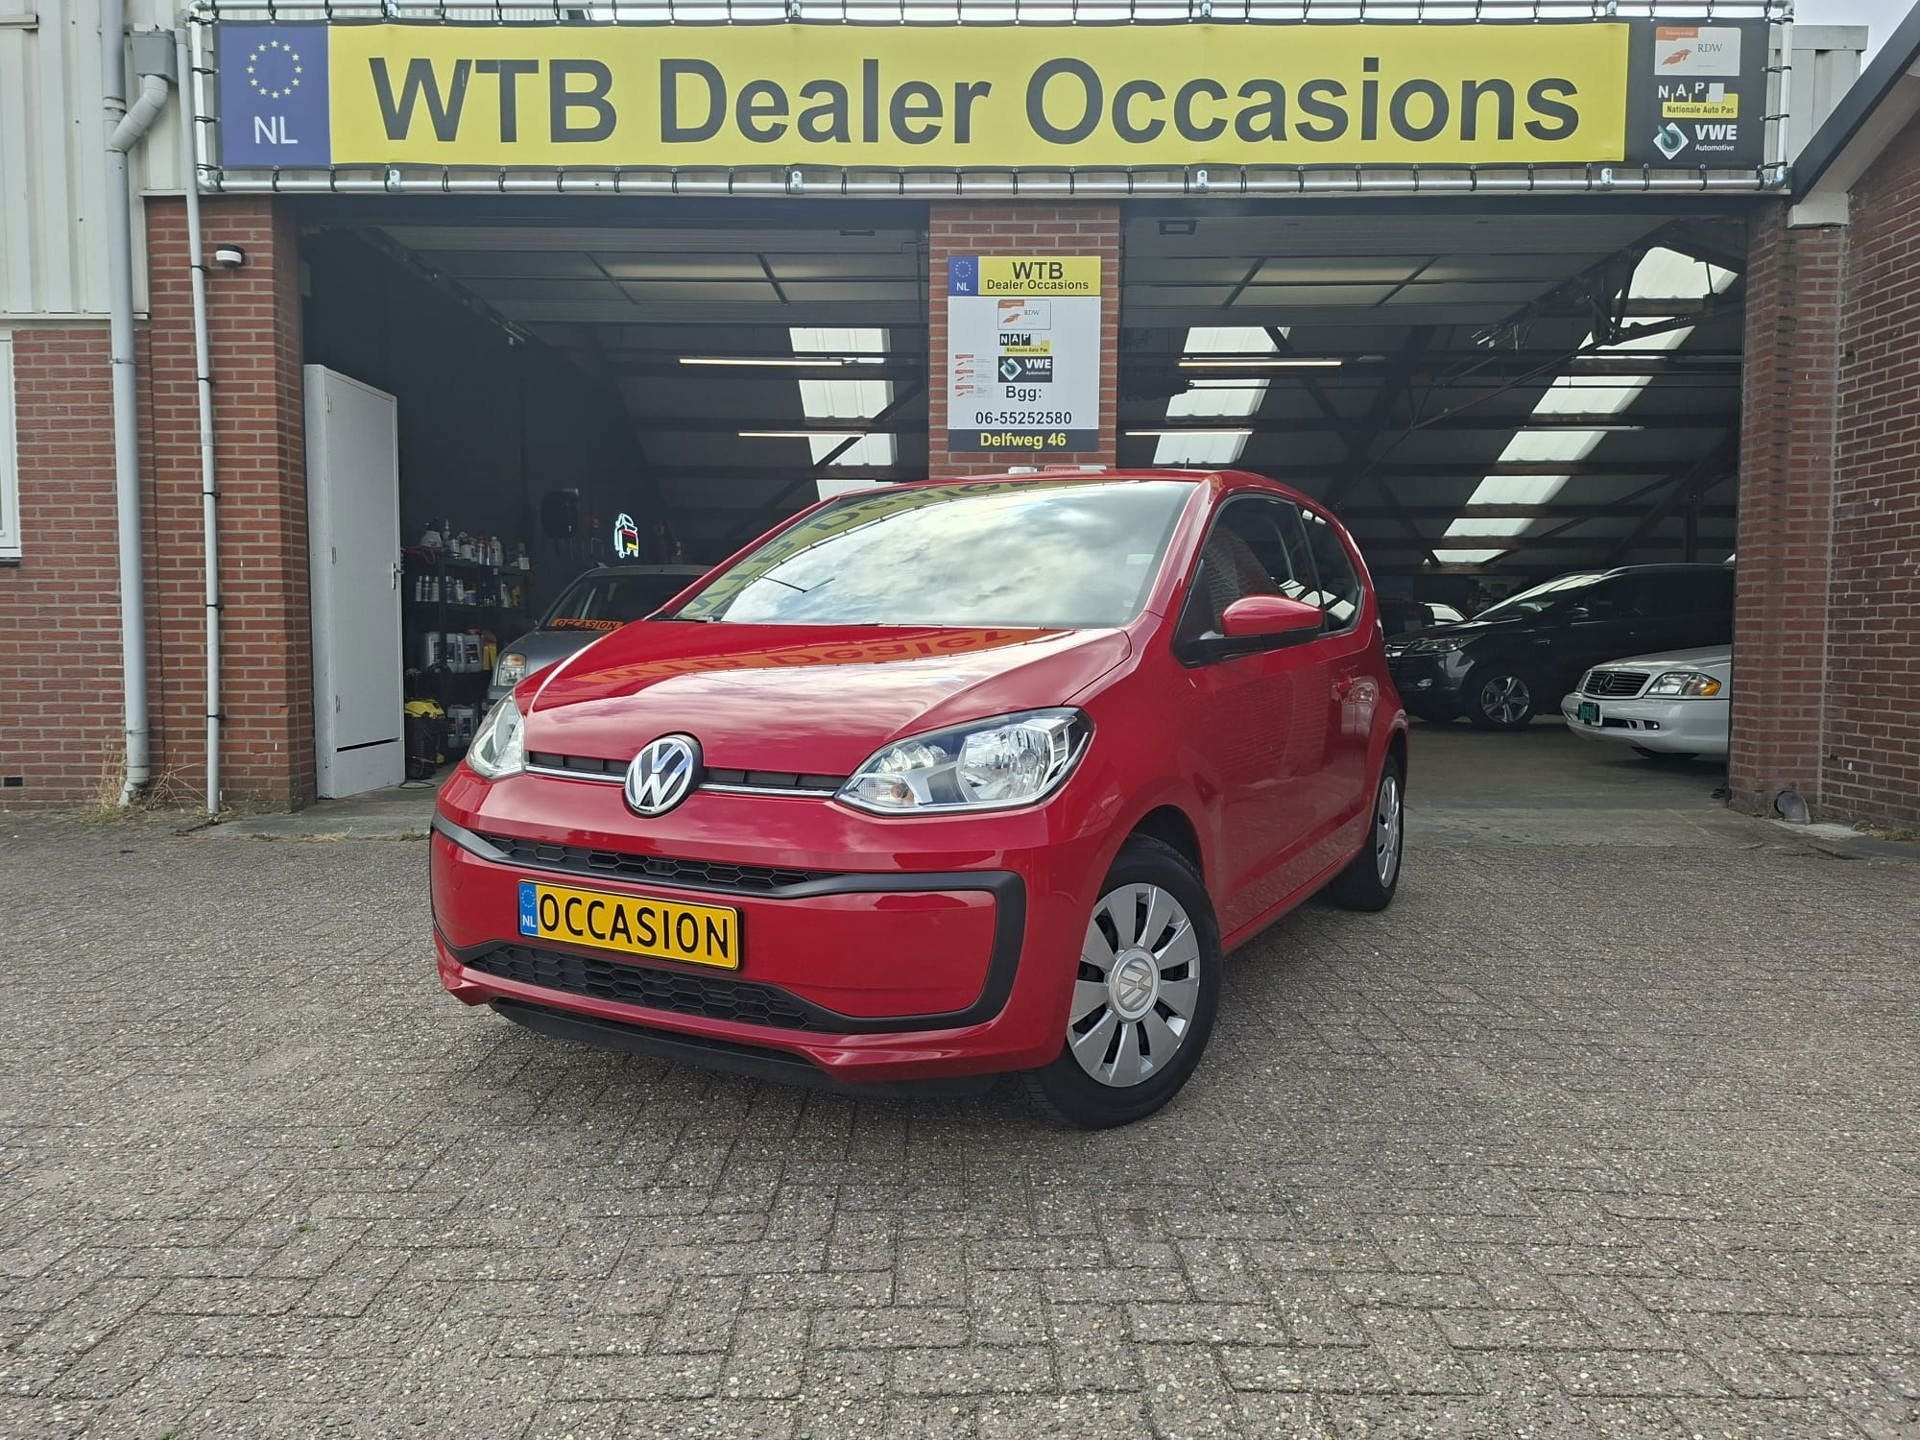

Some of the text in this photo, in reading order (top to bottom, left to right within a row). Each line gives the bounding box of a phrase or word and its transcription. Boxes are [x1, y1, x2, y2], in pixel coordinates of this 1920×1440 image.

[1697, 43, 1723, 53] RDW
[369, 57, 1579, 145] WTB Dealer Occasions
[1666, 105, 1735, 114] Nationale Auto Pas
[253, 115, 298, 145] NL
[1695, 124, 1738, 141] VWE
[1695, 143, 1735, 151] Automotive
[1012, 261, 1064, 280] WTB
[956, 282, 970, 292] NL
[987, 279, 1089, 290] Dealer Occasions
[1025, 358, 1052, 369] VWE
[1006, 385, 1042, 402] Bgg:
[975, 411, 1072, 425] 06-55252580
[980, 432, 1067, 449] Delfweg 46
[556, 618, 618, 630] OCCASION
[522, 914, 537, 928] NL
[539, 893, 728, 958] OCCASION
